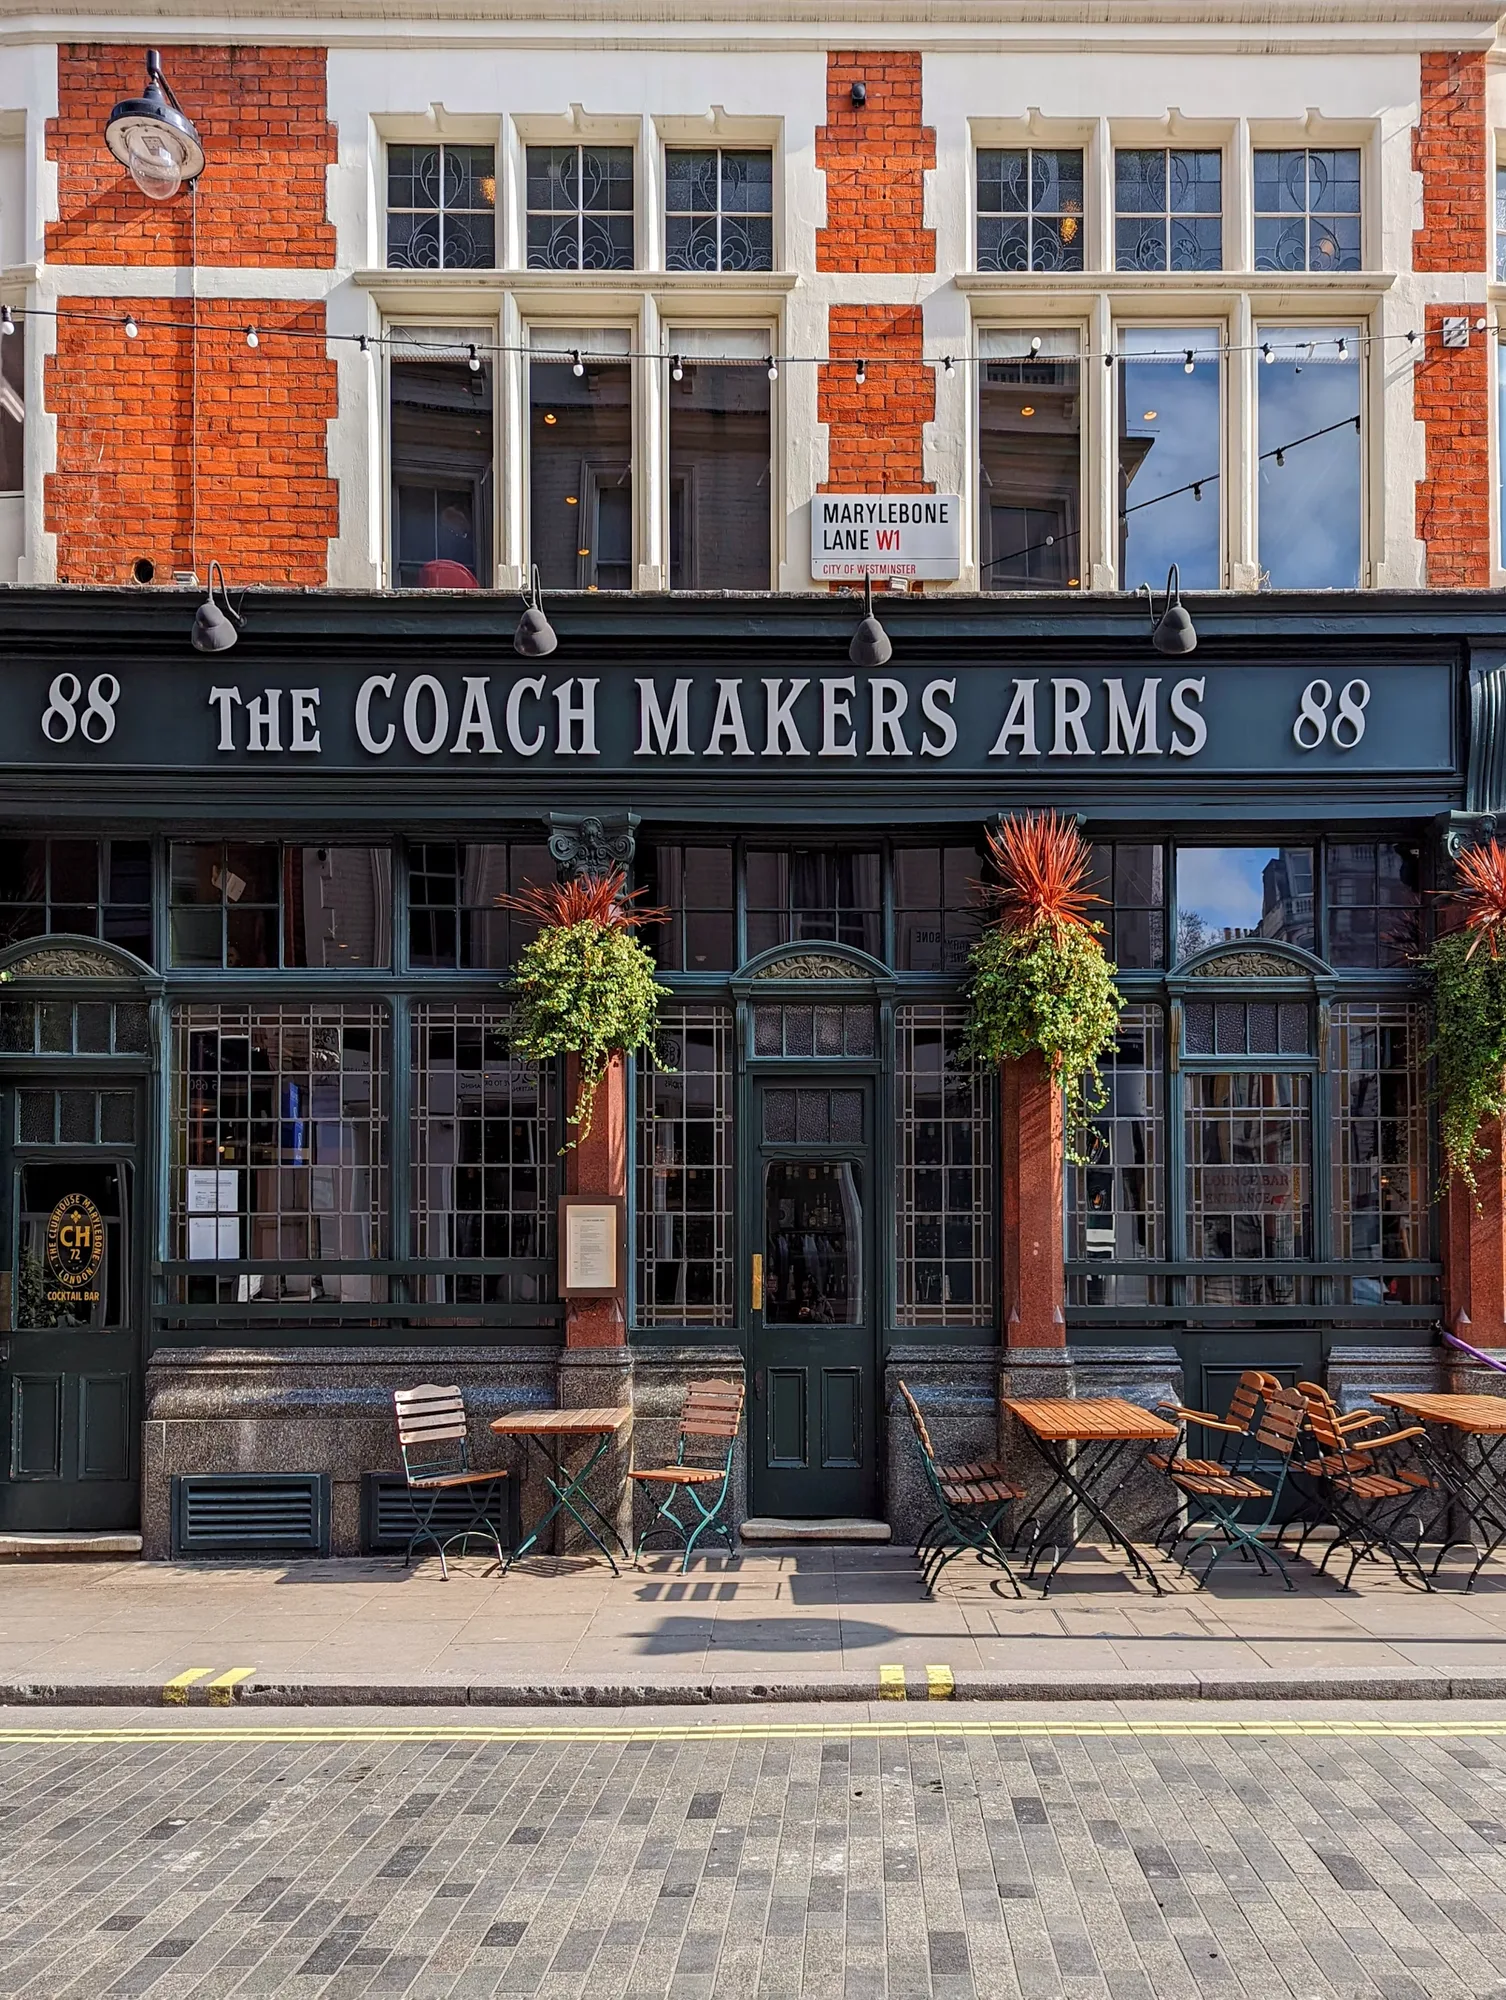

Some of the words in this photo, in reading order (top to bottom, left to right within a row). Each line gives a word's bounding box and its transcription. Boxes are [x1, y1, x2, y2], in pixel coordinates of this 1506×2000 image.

[823, 503, 949, 524] MARYLEBONE
[823, 529, 869, 550] LANE
[876, 529, 900, 551] W1
[823, 564, 841, 575] CITY
[844, 564, 854, 575] OF
[857, 564, 916, 575] WESTMINSTER
[41, 672, 121, 744] 88
[208, 685, 322, 753] THE
[355, 672, 601, 757] COACH
[633, 675, 958, 758] MAKERS
[988, 675, 1208, 757] ARMS
[1292, 678, 1371, 750] 88
[1203, 1174, 1258, 1186] LOUNGE
[1262, 1174, 1289, 1186] BAR
[1205, 1193, 1271, 1204] ENTRANCE
[49, 1195, 80, 1239] CLUBHOUSE
[60, 1225, 90, 1247] CH
[82, 1198, 103, 1261] MARYLEBONE
[49, 1242, 58, 1261] THE
[70, 1249, 81, 1260] 72
[58, 1267, 94, 1285] LONDON
[47, 1291, 82, 1301] COCKTAIL
[84, 1291, 100, 1301] BAR
